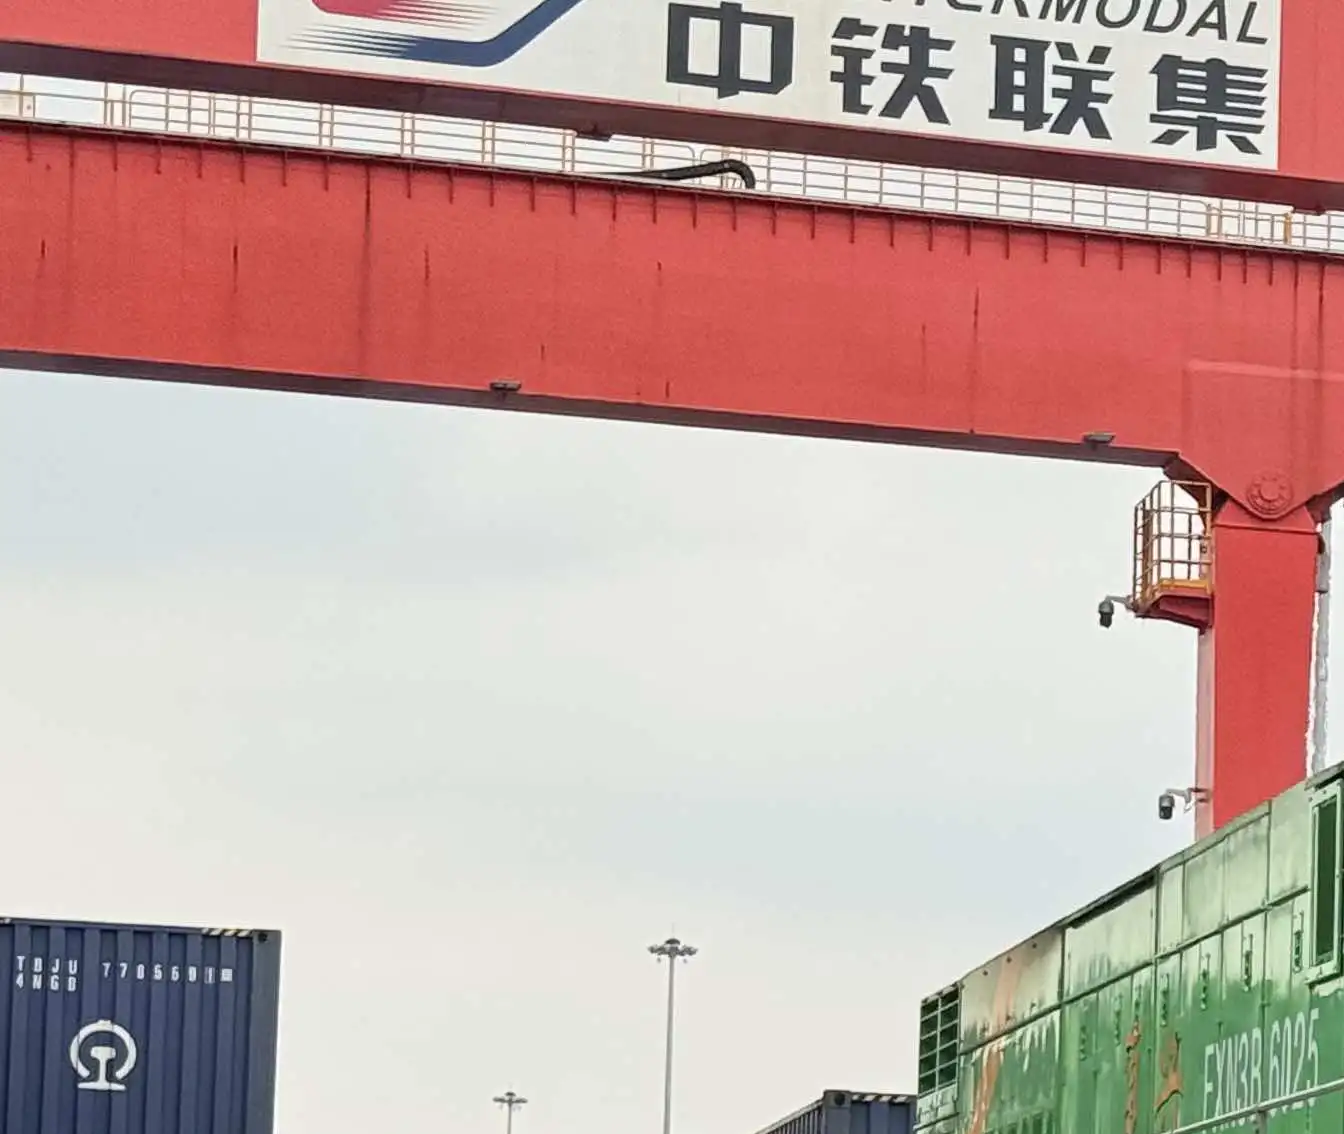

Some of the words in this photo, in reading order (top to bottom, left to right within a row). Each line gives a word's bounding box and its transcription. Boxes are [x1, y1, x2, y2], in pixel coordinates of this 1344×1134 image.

[666, 1, 1268, 155] 中铁联集
[1267, 1007, 1320, 1118] 6025
